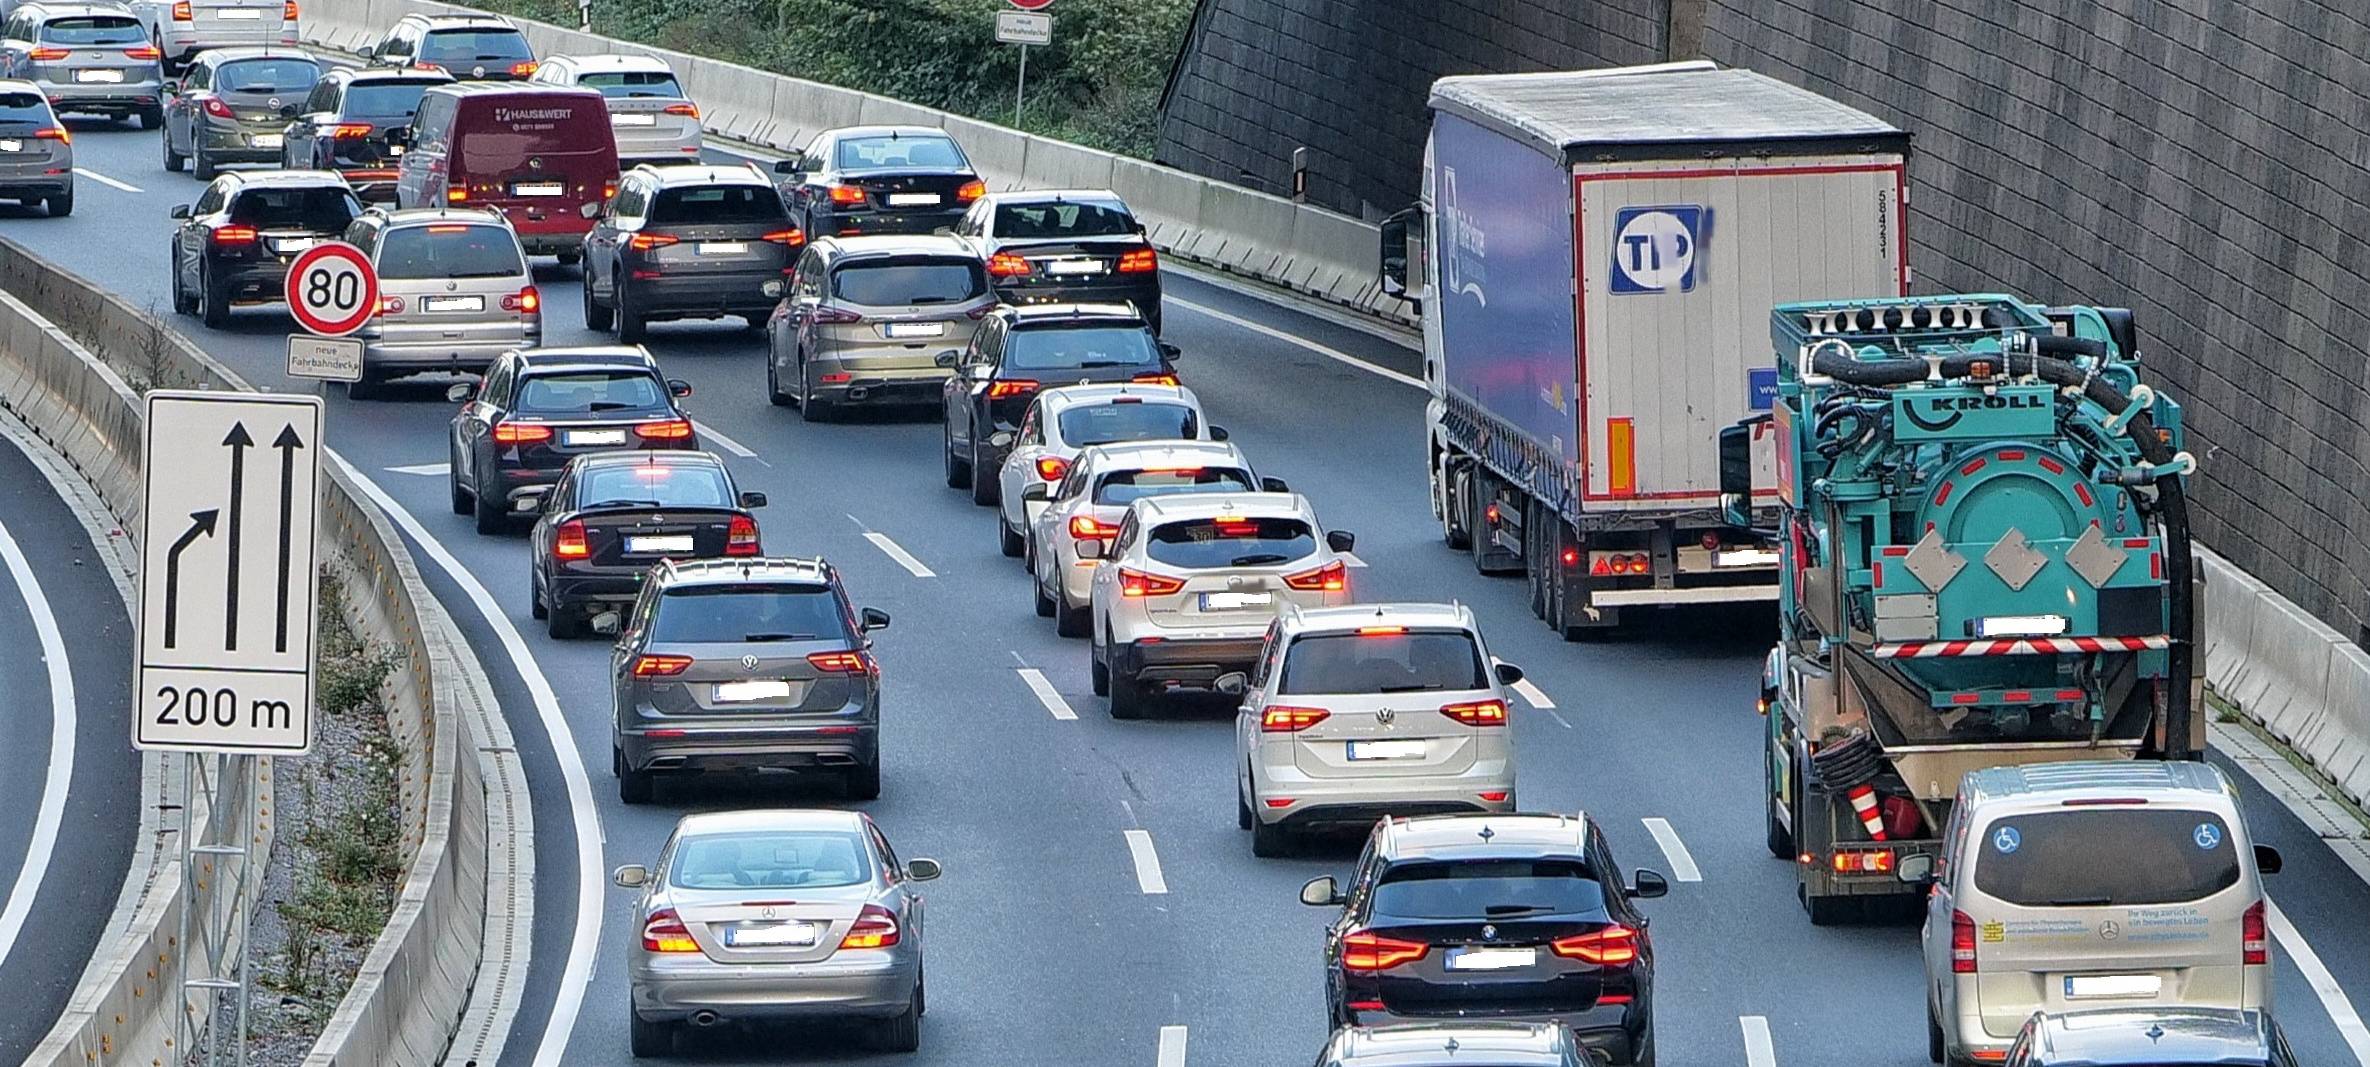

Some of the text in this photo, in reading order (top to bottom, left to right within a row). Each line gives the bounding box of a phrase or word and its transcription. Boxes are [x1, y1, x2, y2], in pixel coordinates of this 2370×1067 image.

[511, 108, 572, 119] HAUS&WERT
[307, 268, 359, 310] 80
[1931, 396, 2046, 411] KROLL
[157, 686, 290, 728] 200 m
